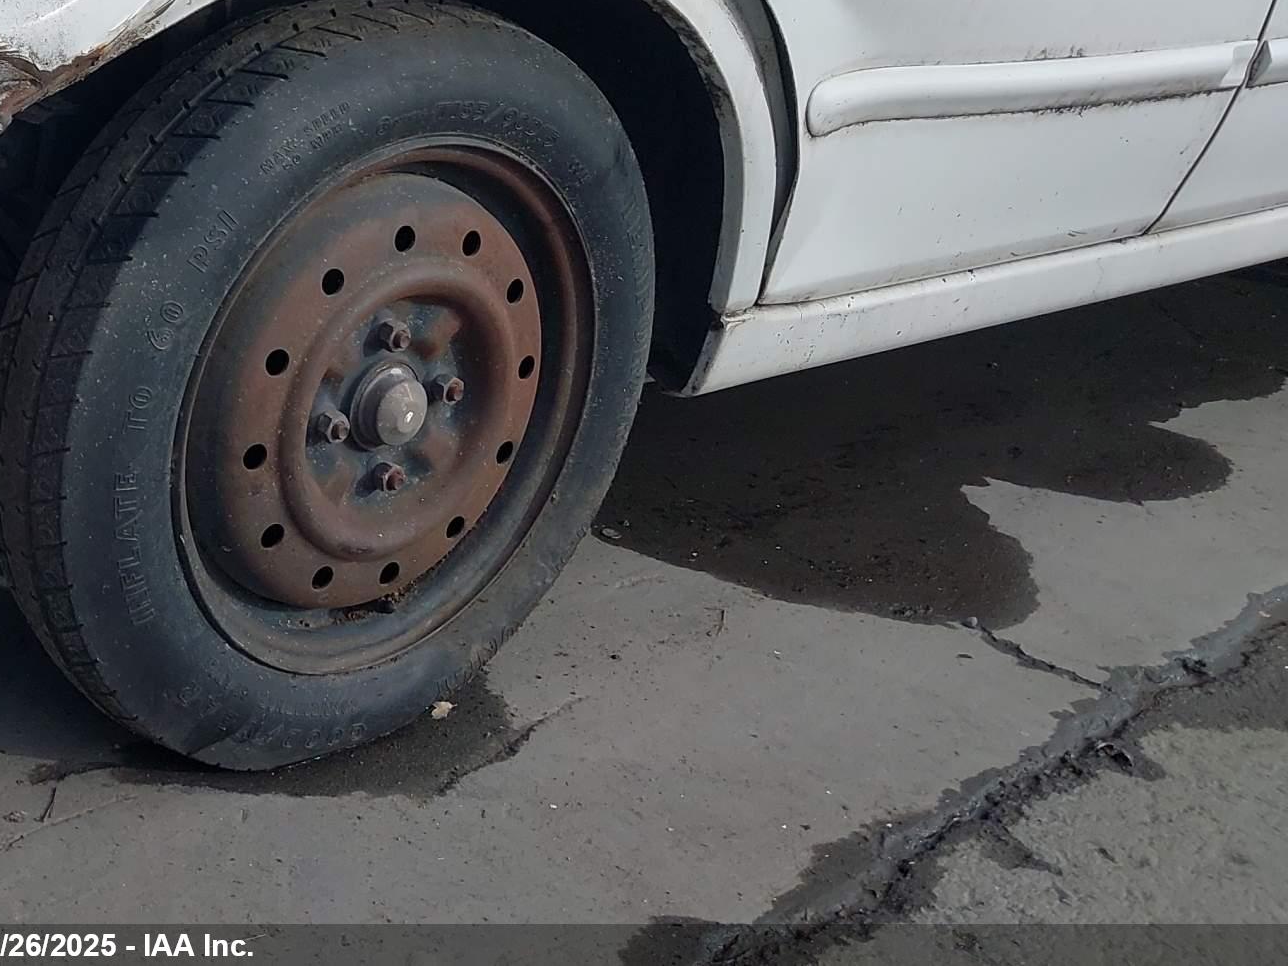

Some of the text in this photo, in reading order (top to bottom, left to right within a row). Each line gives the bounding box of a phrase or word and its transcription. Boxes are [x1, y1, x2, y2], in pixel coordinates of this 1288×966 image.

[113, 209, 240, 627] INFLATE TO 60 PSI
